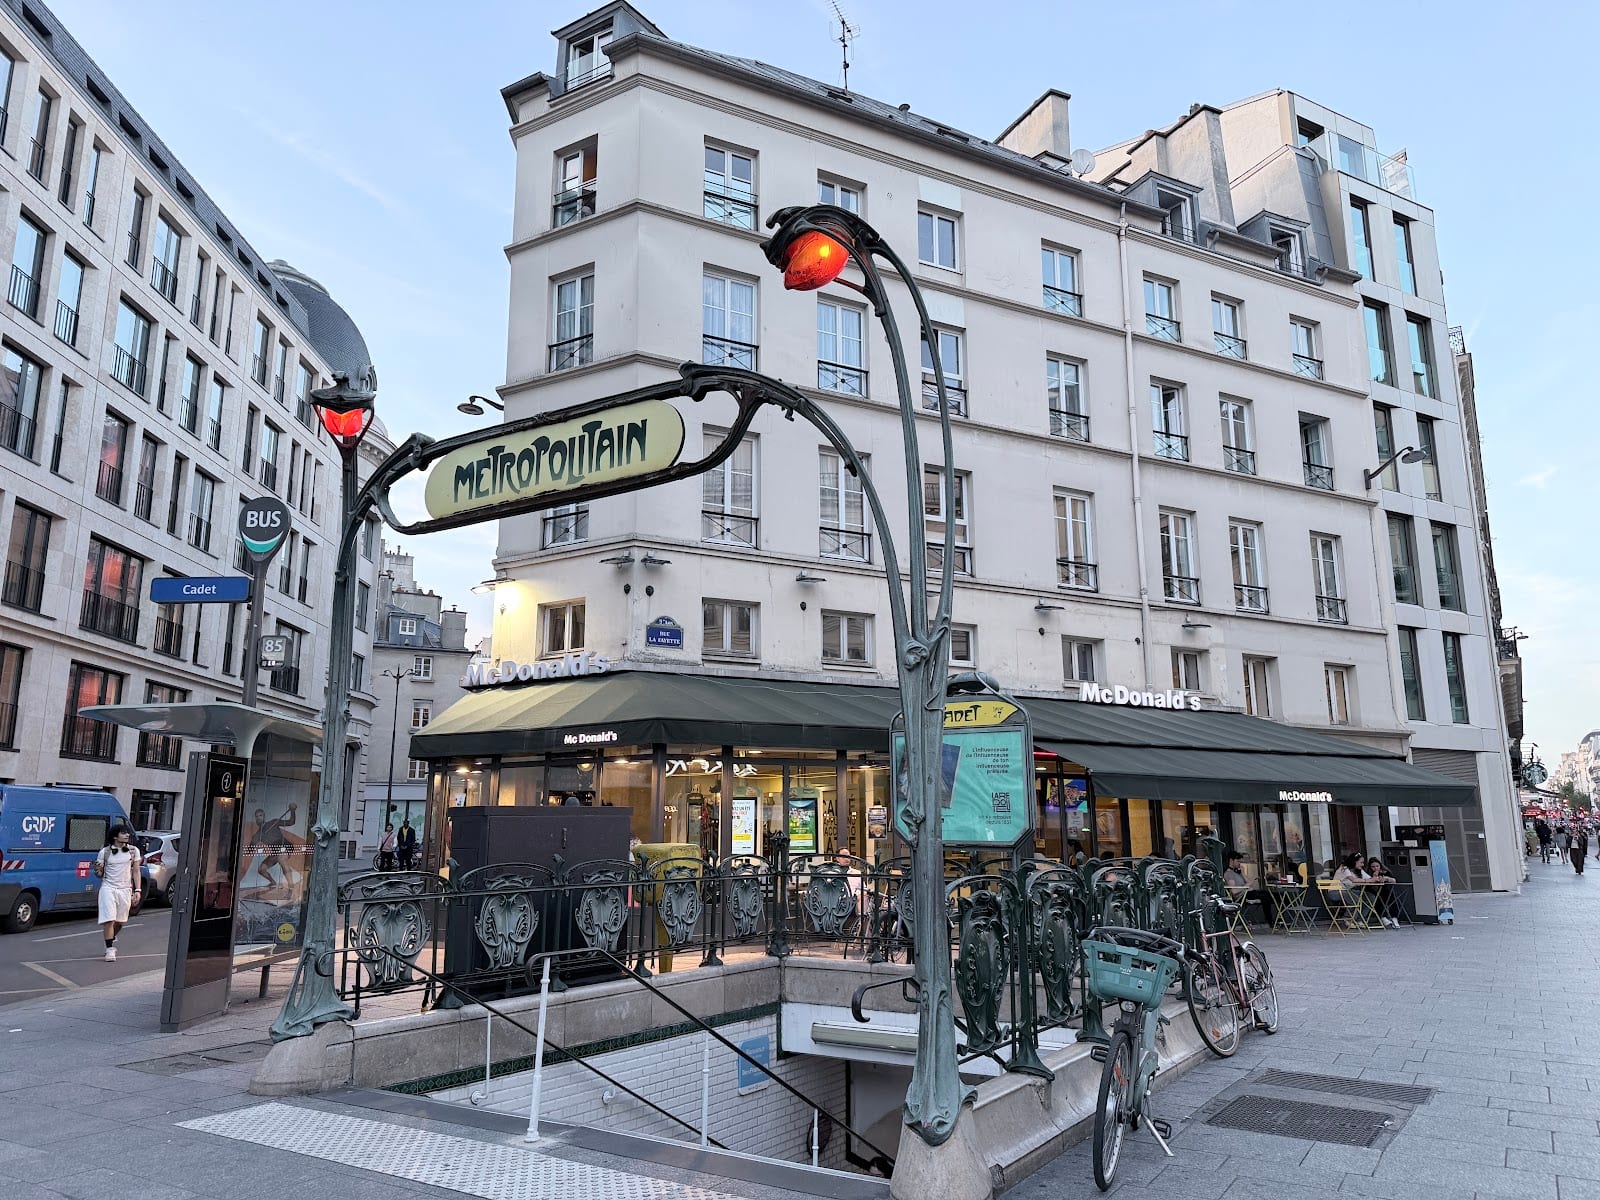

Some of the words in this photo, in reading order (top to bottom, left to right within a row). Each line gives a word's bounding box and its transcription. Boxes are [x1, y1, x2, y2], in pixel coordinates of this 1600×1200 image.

[453, 418, 648, 504] METROPOLITAIN
[246, 510, 281, 528] BUS
[182, 584, 217, 595] Cadet
[265, 639, 282, 652] 85
[466, 651, 611, 686] McDonald's
[1080, 681, 1201, 711] McDonald's
[944, 704, 982, 723] ADET
[1279, 790, 1333, 802] McDonald's
[22, 816, 57, 833] GRDF
